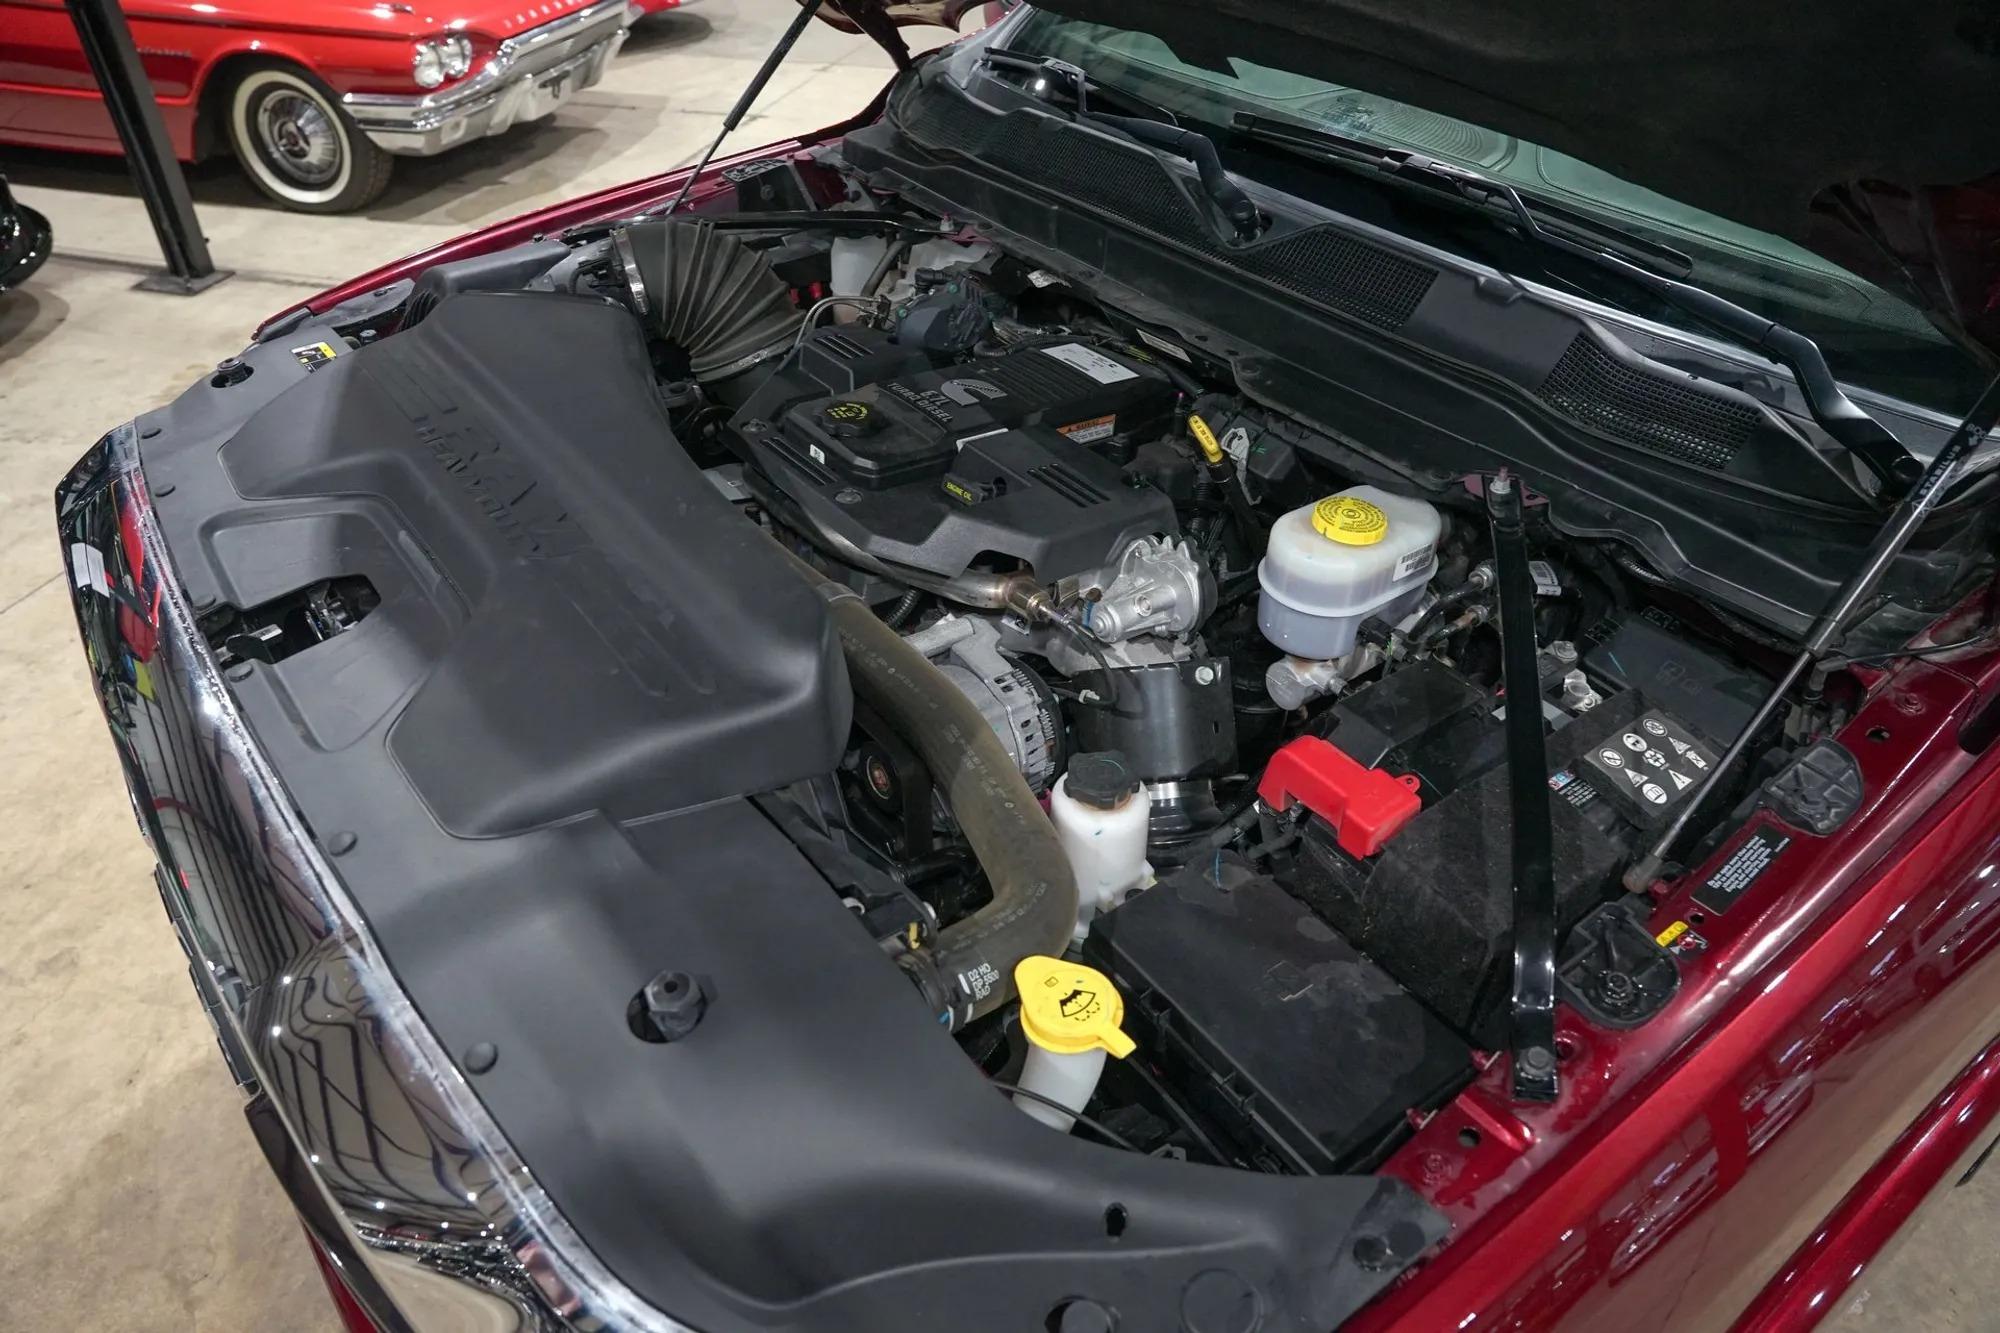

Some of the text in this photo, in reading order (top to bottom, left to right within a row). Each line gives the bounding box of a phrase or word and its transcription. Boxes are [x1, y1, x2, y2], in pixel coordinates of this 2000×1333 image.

[887, 382, 954, 422] TURBO DIESEL
[1919, 444, 1962, 495] STABILUS
